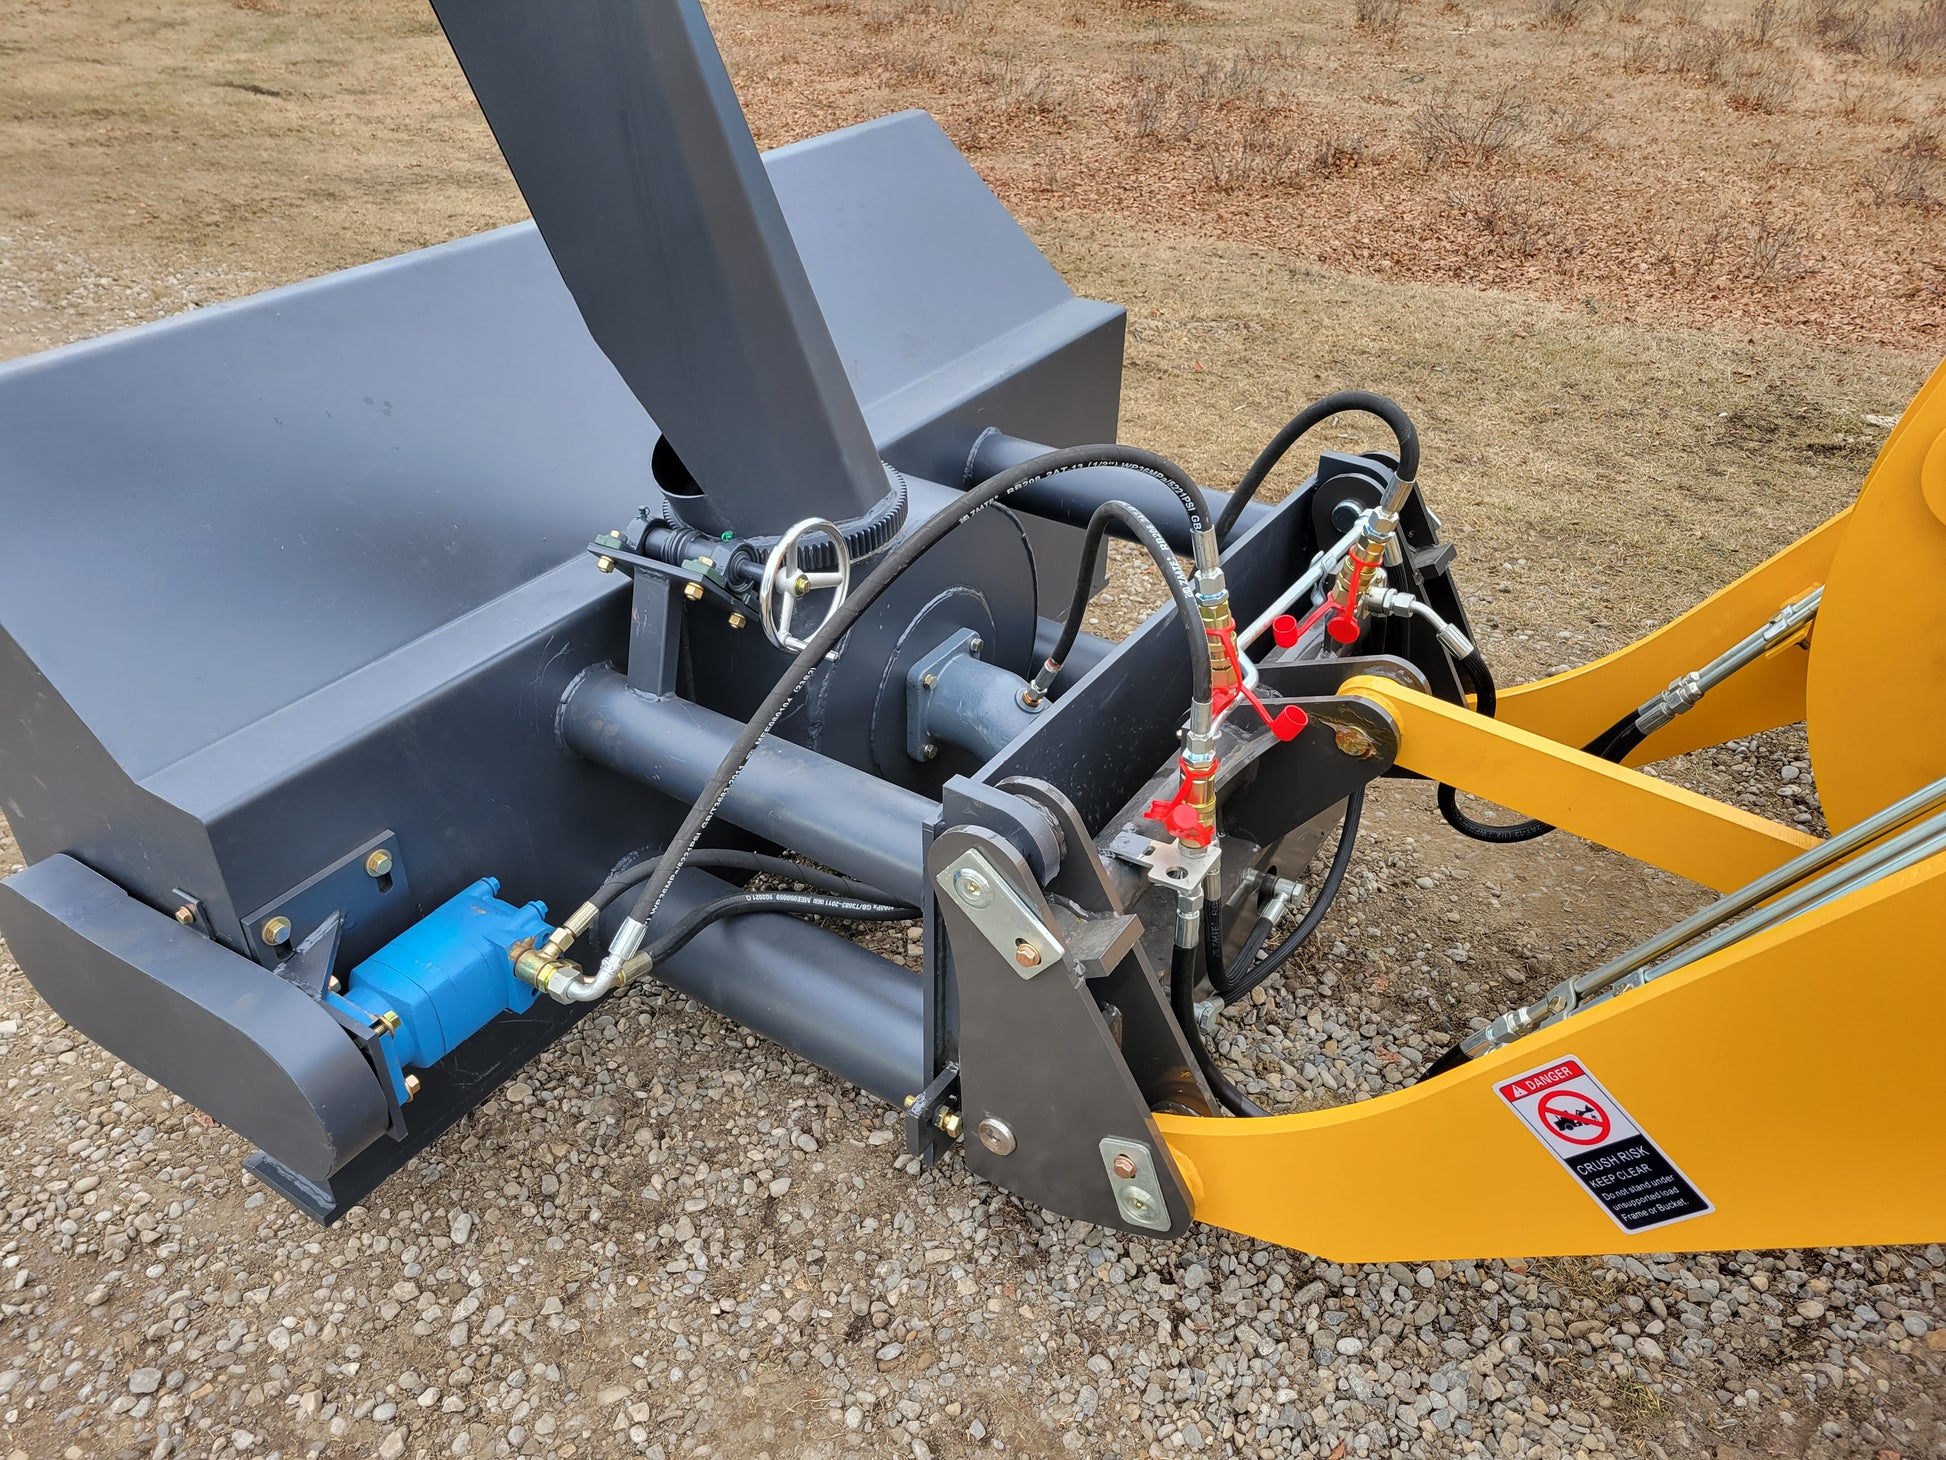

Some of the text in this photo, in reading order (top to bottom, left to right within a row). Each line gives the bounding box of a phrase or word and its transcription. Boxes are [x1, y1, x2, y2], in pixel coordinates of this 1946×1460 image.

[1525, 1066, 1573, 1091] DANGER
[1576, 1145, 1650, 1176] CRUSH RISK
[1589, 1163, 1653, 1189] KEEP CLEAR
[1601, 1173, 1676, 1202] Do not stand under
[1612, 1186, 1680, 1213] unsupported load
[1621, 1197, 1690, 1223] Frame or Bucket.
